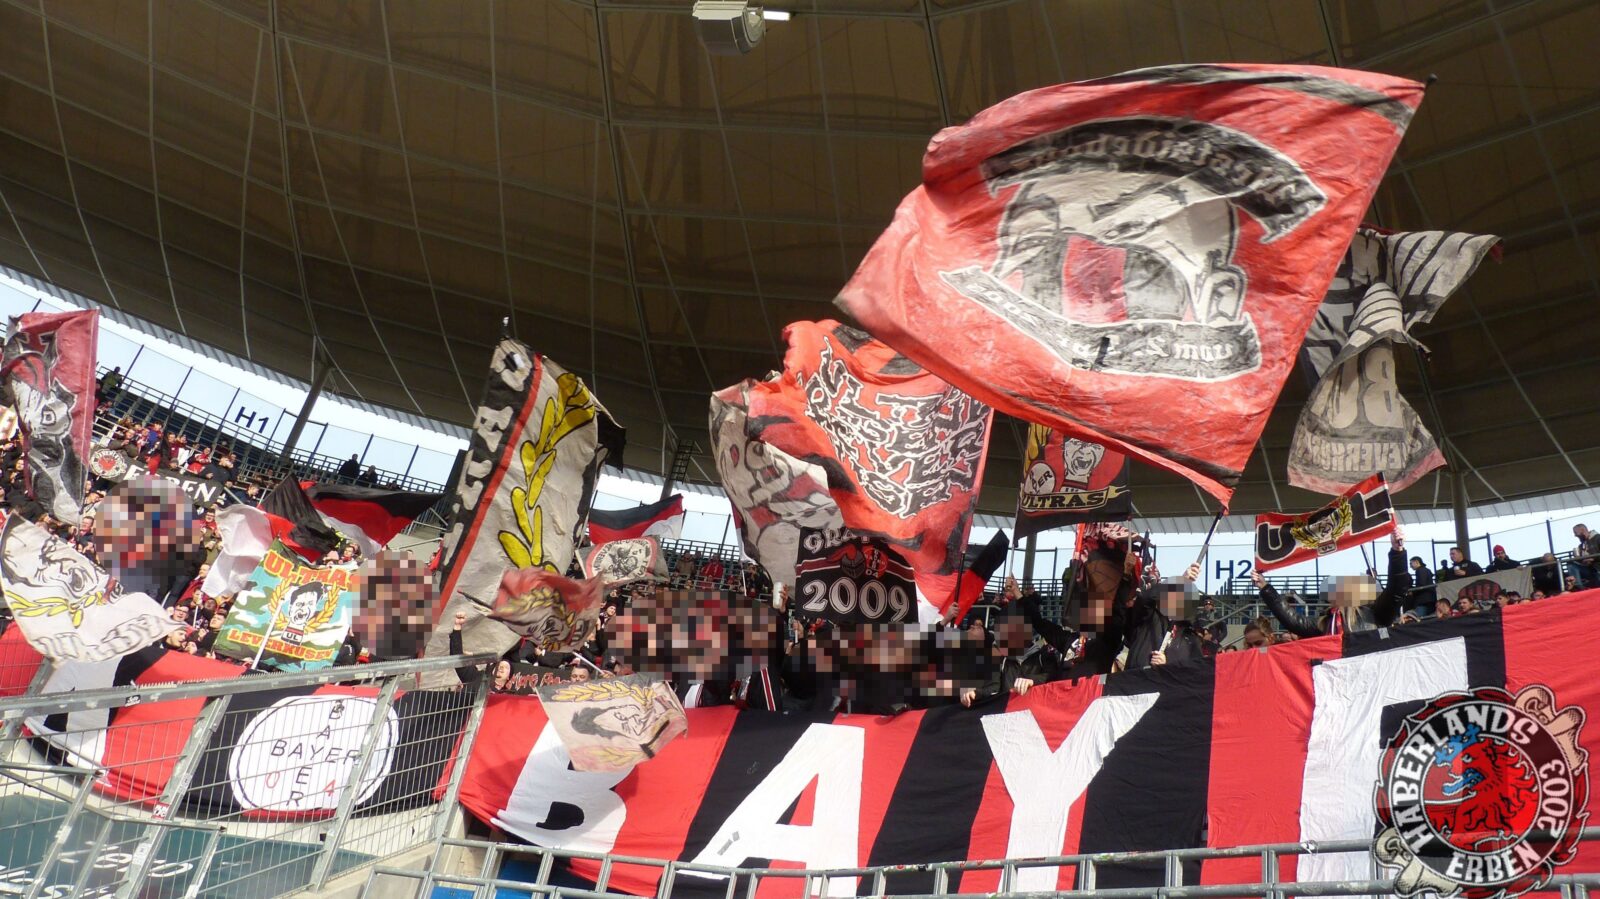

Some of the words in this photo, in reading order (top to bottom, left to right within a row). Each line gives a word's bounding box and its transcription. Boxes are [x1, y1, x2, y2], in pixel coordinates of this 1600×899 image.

[235, 406, 270, 434] H1
[124, 464, 217, 503] EEN
[1021, 492, 1104, 509] ULTRAS
[263, 549, 360, 591] ULTRA
[1216, 560, 1253, 580] H2
[802, 577, 910, 622] 2009
[227, 628, 334, 661] LEVERKUSEN
[286, 632, 298, 641] UL
